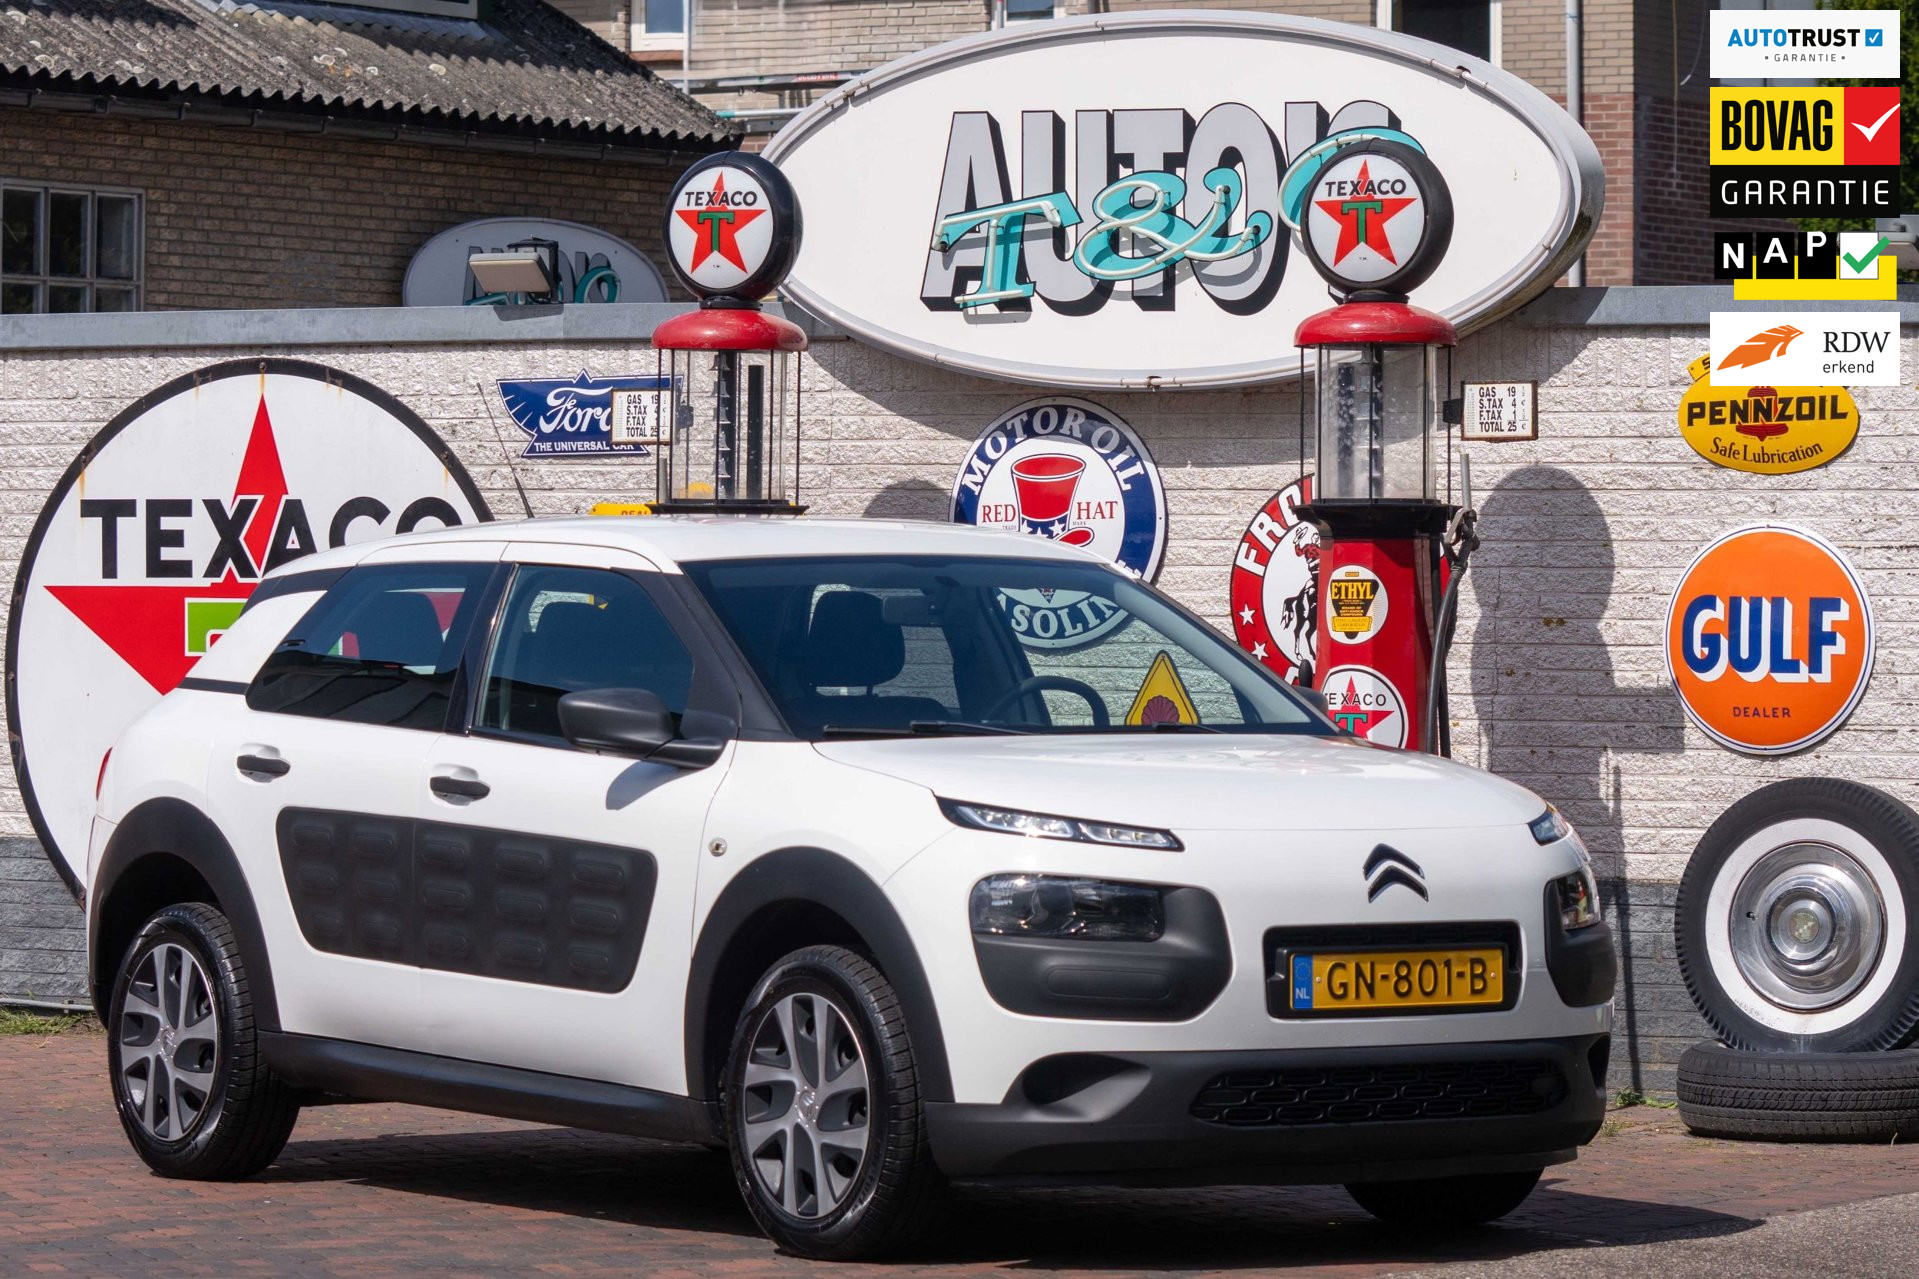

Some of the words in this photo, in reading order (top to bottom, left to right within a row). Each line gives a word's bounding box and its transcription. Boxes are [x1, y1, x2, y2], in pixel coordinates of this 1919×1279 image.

[1324, 178, 1407, 197] TEXACO
[684, 190, 758, 207] TEXACO
[1341, 200, 1384, 244] T
[697, 210, 736, 253] T
[626, 394, 642, 405] GAS
[1479, 386, 1496, 398] GAS
[1507, 386, 1516, 397] 19
[626, 405, 647, 415] S.TAX
[1478, 398, 1504, 409] S.TAX
[1511, 398, 1517, 408] 4
[1687, 394, 1849, 427] PENNZOIL
[626, 416, 646, 426] F.TAX
[1479, 409, 1503, 421] F.TAX
[626, 427, 648, 437] TOTAL
[1479, 421, 1504, 432] TOTAL
[1507, 421, 1517, 432] 25
[534, 442, 551, 452] THE
[554, 441, 610, 451] UNIVERSAL
[961, 406, 1086, 496] MOTOR
[1091, 425, 1145, 492] OIL
[1710, 436, 1740, 459] Safe
[1743, 442, 1823, 464] Lubrication
[982, 503, 1017, 523] RED
[1076, 501, 1118, 520] HAT
[1235, 477, 1315, 576] FRO
[1331, 581, 1374, 599] ETHYL
[1682, 594, 1850, 683] GULF
[1732, 706, 1791, 718] DEALER
[1326, 957, 1488, 1000] GN-801-B
[1295, 987, 1311, 1000] NL
